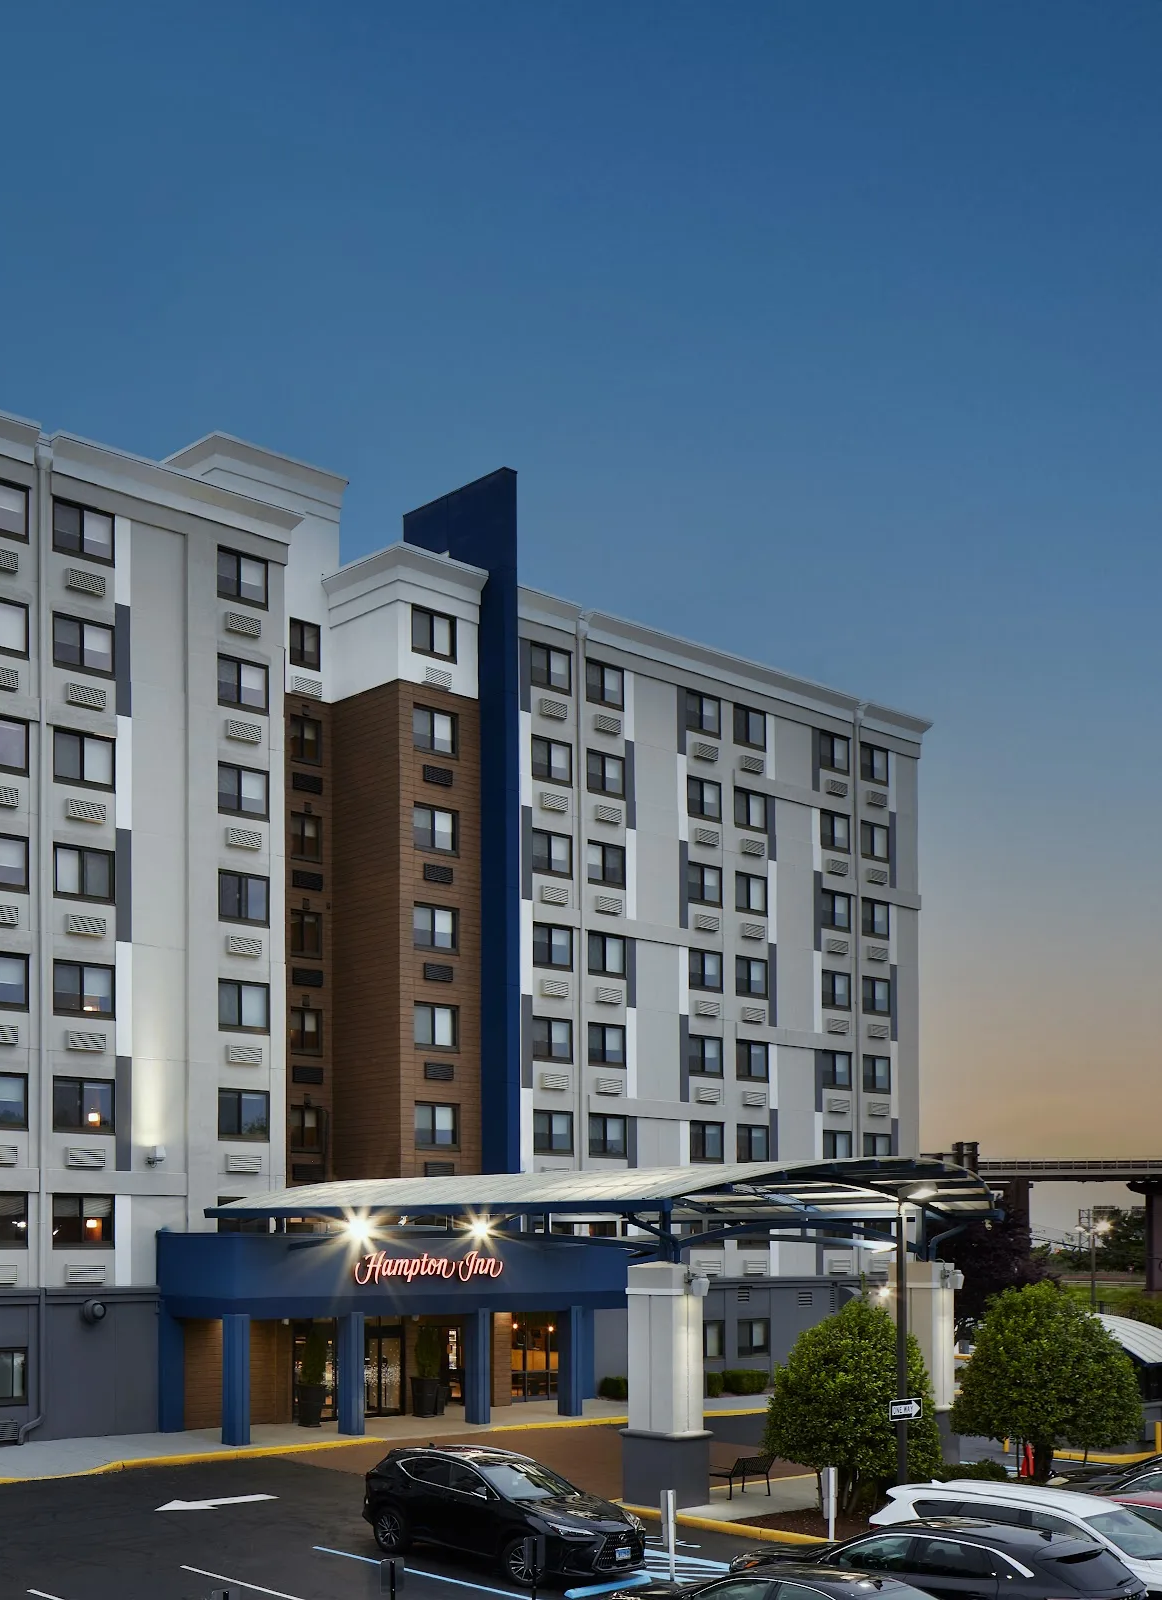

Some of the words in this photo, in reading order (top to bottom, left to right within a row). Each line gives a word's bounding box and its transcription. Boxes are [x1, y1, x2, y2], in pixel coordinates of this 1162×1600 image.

[354, 1250, 455, 1285] Hampton
[458, 1250, 503, 1282] Inn
[893, 1406, 903, 1414] ONE
[903, 1405, 913, 1413] WAY
